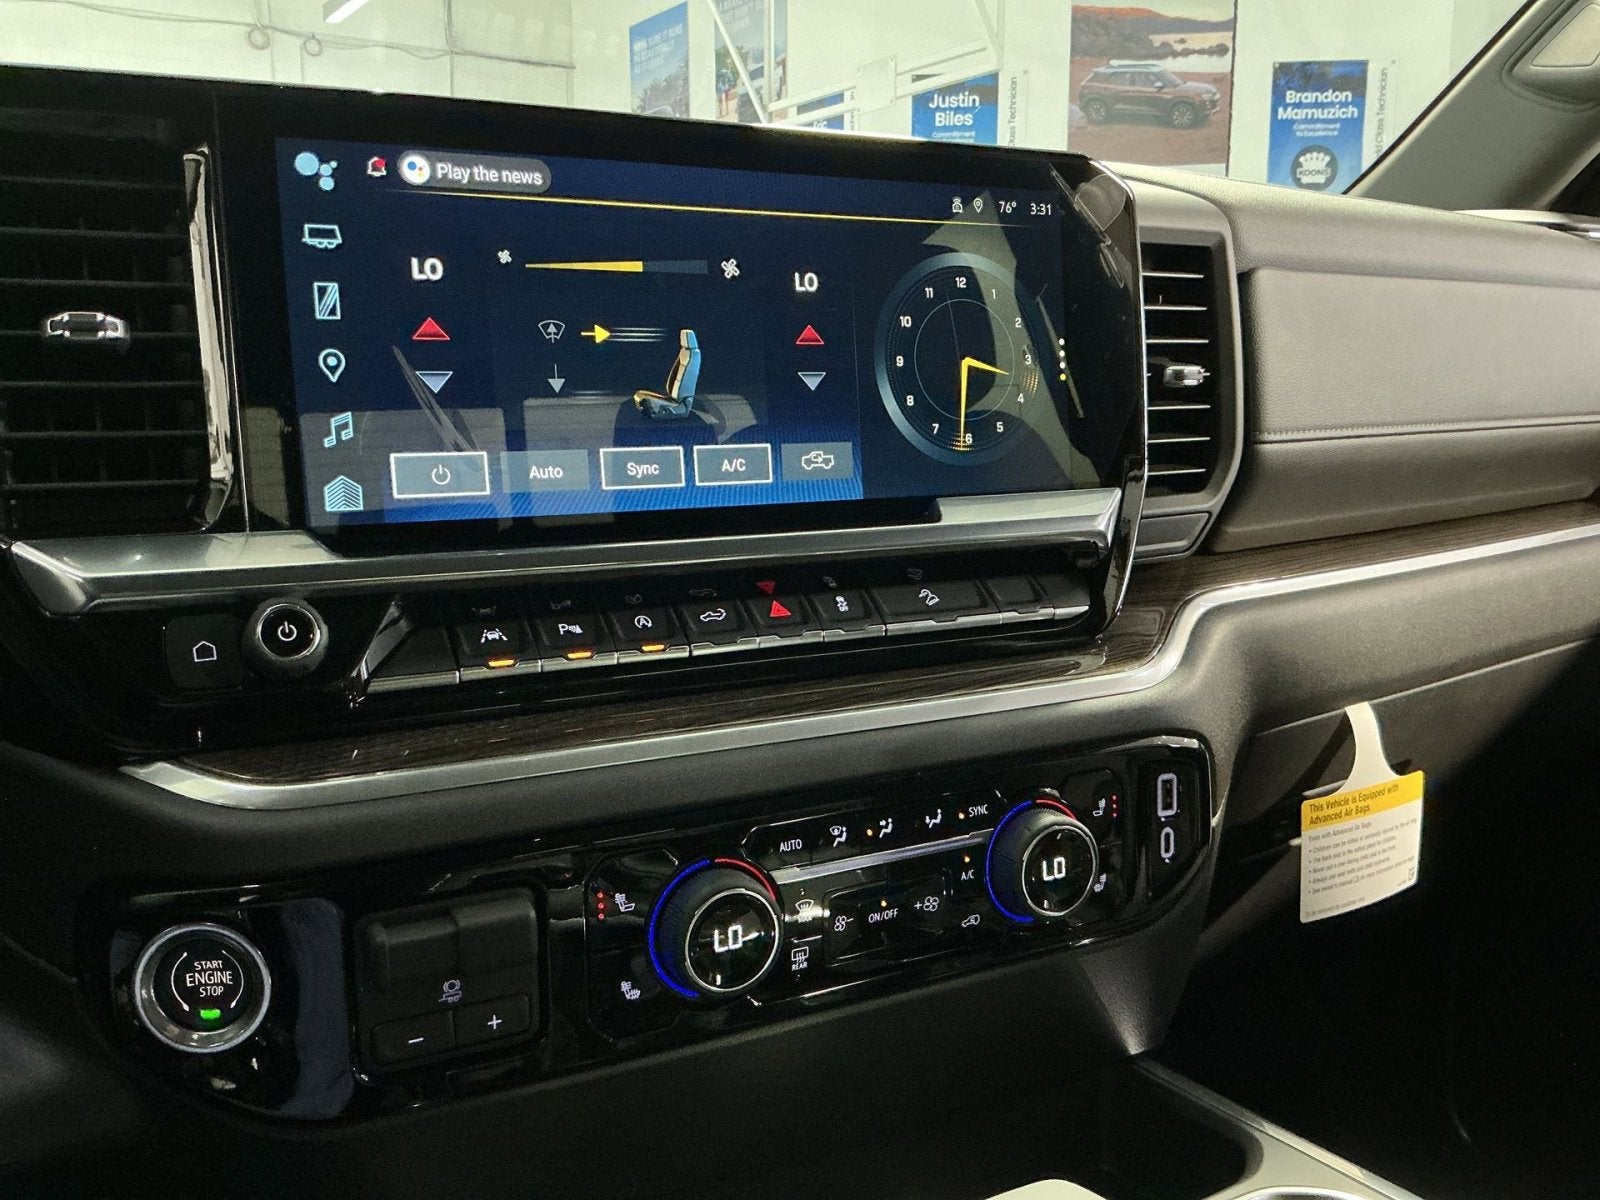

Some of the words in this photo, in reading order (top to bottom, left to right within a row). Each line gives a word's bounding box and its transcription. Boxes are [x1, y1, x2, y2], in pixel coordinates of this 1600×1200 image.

[1285, 89, 1352, 103] Brandon
[1377, 67, 1389, 116] Technician
[928, 91, 980, 109] Justin
[1008, 76, 1018, 124] Technician
[935, 110, 974, 127] Biles
[1277, 105, 1358, 120] Mamuzich
[436, 162, 471, 184] Play
[474, 165, 499, 182] the
[502, 169, 543, 185] news
[1030, 203, 1052, 216] 3:31
[410, 256, 444, 282] LO
[794, 272, 819, 292] LO
[955, 276, 967, 288] 12
[925, 287, 934, 299] 11
[899, 316, 912, 328] 10
[1015, 317, 1022, 328] 2
[896, 355, 904, 367] 9
[1024, 354, 1032, 365] 3
[906, 395, 915, 407] 8
[1017, 393, 1024, 404] 4
[932, 423, 940, 434] 7
[996, 421, 1004, 433] 5
[965, 433, 973, 444] 6
[529, 465, 564, 479] Auto
[626, 461, 660, 477] Sync
[721, 458, 746, 472] A/C
[1309, 803, 1324, 814] This
[1325, 796, 1350, 810] Vehicle
[1351, 795, 1357, 805] is
[1358, 787, 1386, 803] Equipped
[1386, 783, 1399, 794] with
[968, 804, 989, 818] SYNC
[1309, 811, 1343, 826] Advanced
[1344, 808, 1354, 817] Air
[1355, 804, 1370, 816] Bags
[779, 838, 803, 853] AUTO
[960, 869, 975, 881] A/C
[1041, 856, 1066, 882] LO
[868, 908, 899, 924] ON/OFF
[713, 924, 743, 953] LO
[193, 960, 223, 971] START
[791, 961, 808, 972] REAR
[185, 971, 234, 987] ENGINE
[199, 986, 224, 998] STOP
